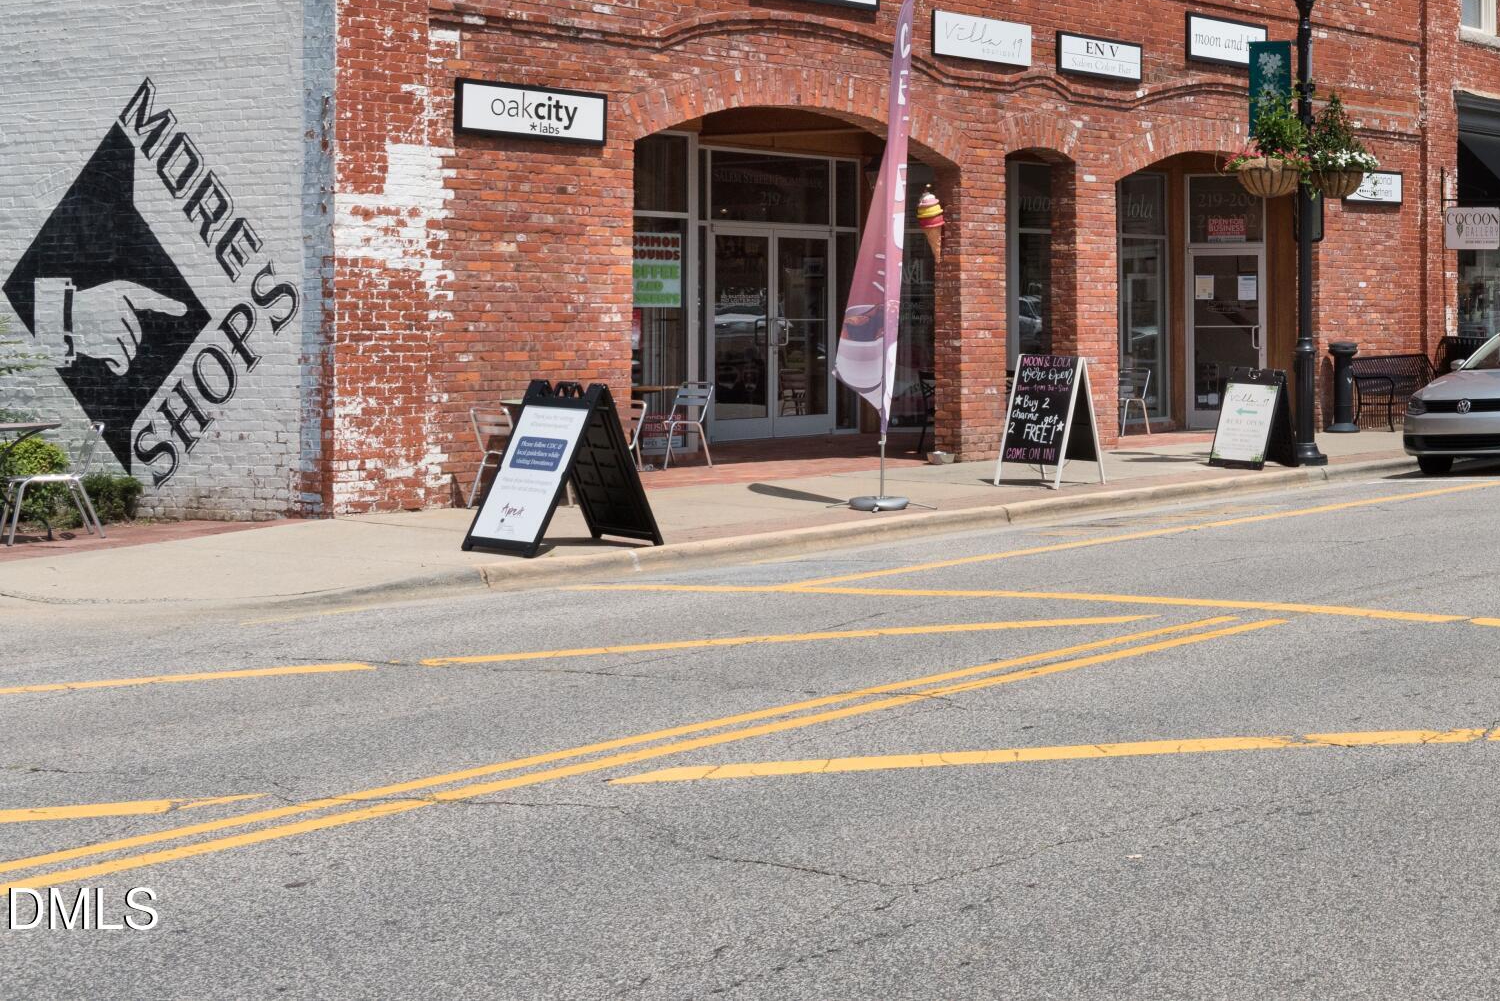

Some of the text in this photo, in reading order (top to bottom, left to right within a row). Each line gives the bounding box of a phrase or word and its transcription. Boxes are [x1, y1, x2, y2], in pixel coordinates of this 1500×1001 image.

[1086, 41, 1120, 58] EN V
[1194, 33, 1221, 48] moon
[1224, 34, 1243, 51] and
[1071, 57, 1132, 75] Salon Color Bar
[118, 76, 263, 283] MORE
[1447, 213, 1499, 225] COCOON
[1465, 226, 1499, 237] GALLERY
[632, 235, 680, 248] OMMON
[632, 249, 680, 260] ROUNDS
[632, 264, 680, 279] OFFEE
[1022, 357, 1044, 367] MOON
[1053, 357, 1071, 367] LOLA
[133, 259, 300, 490] SHOPS
[1023, 394, 1050, 412] Buy 2
[1012, 408, 1059, 426] charms get
[645, 423, 682, 432] BUSISS
[1008, 421, 1056, 445] 2 FREE!
[1006, 447, 1027, 459] COME
[1029, 447, 1041, 460] ON
